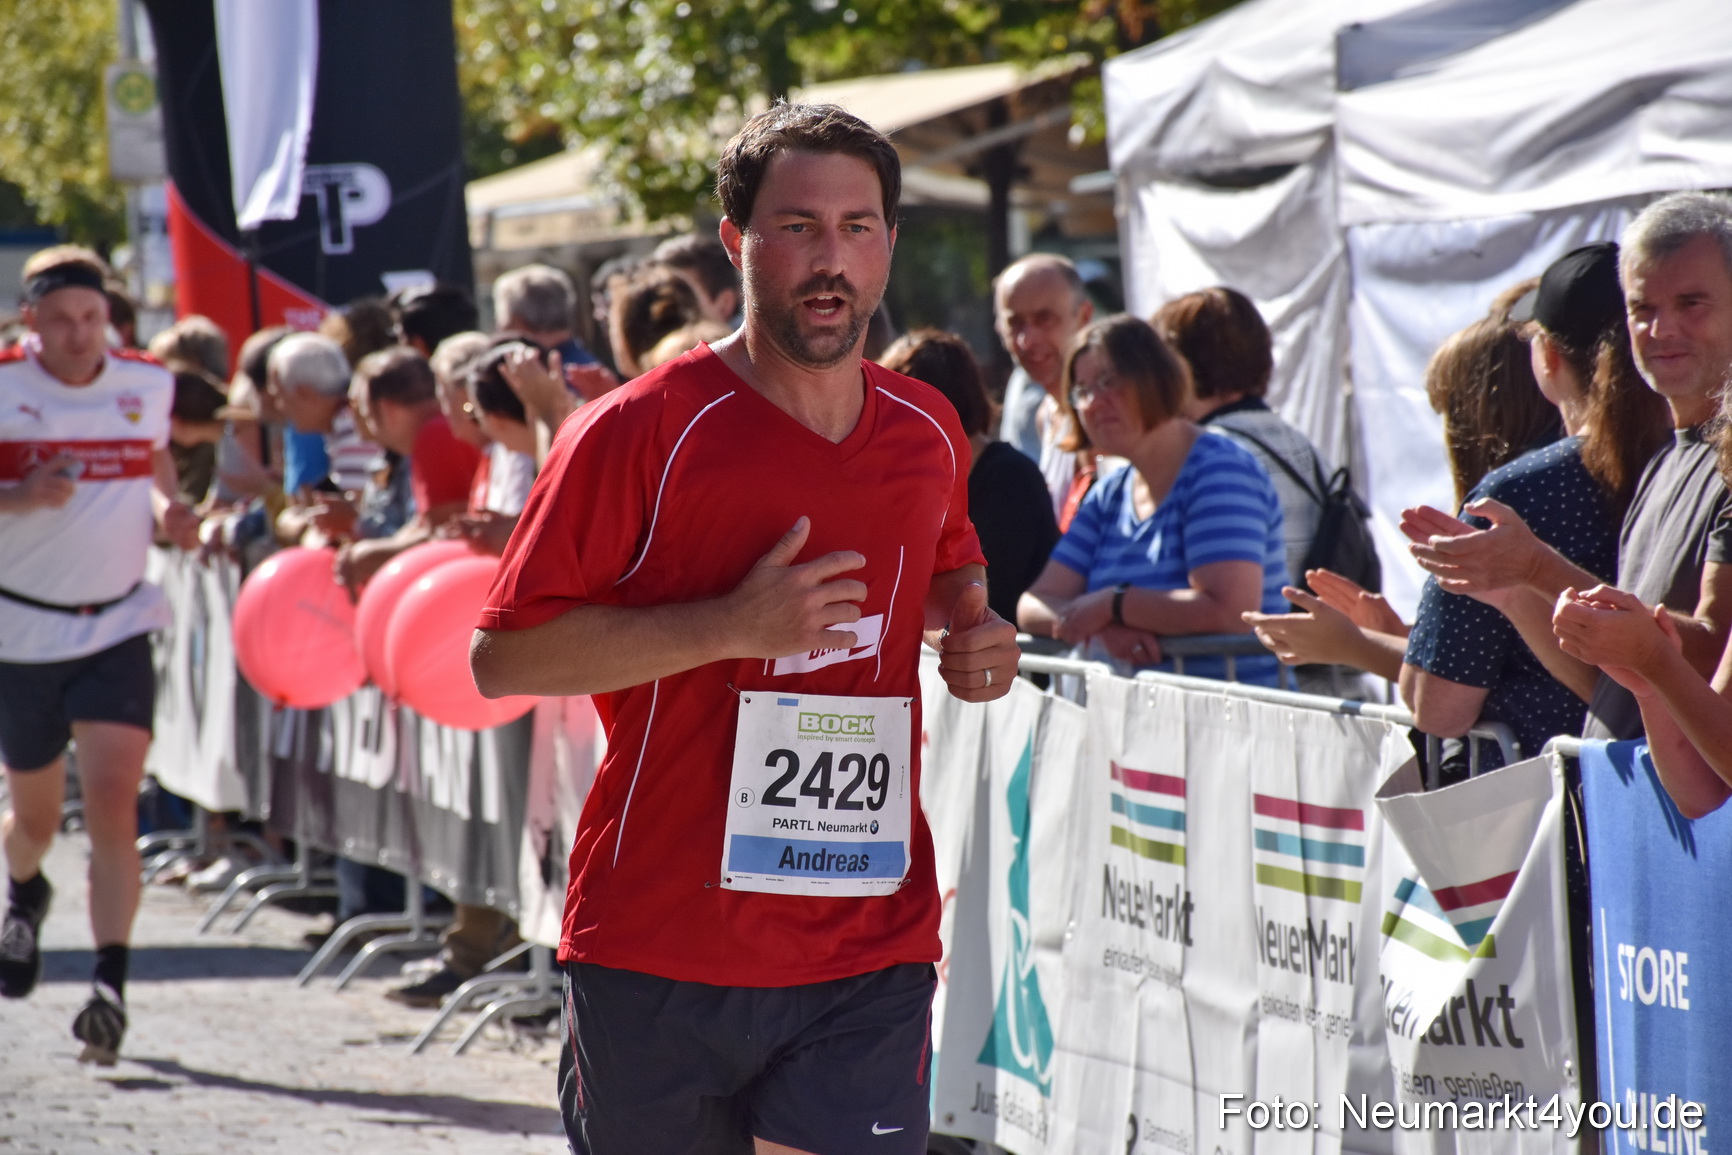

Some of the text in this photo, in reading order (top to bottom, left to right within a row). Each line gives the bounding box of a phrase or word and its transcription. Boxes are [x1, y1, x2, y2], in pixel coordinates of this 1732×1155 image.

[798, 712, 875, 735] BOCK
[797, 733, 824, 742] inspired
[825, 735, 834, 743] by
[761, 749, 890, 812] 2429
[741, 792, 748, 803] B
[772, 817, 868, 833] PARTL Neumarkt
[778, 845, 870, 873] Andreas
[1618, 943, 1690, 1010] STORE
[1443, 1071, 1525, 1103] genießen
